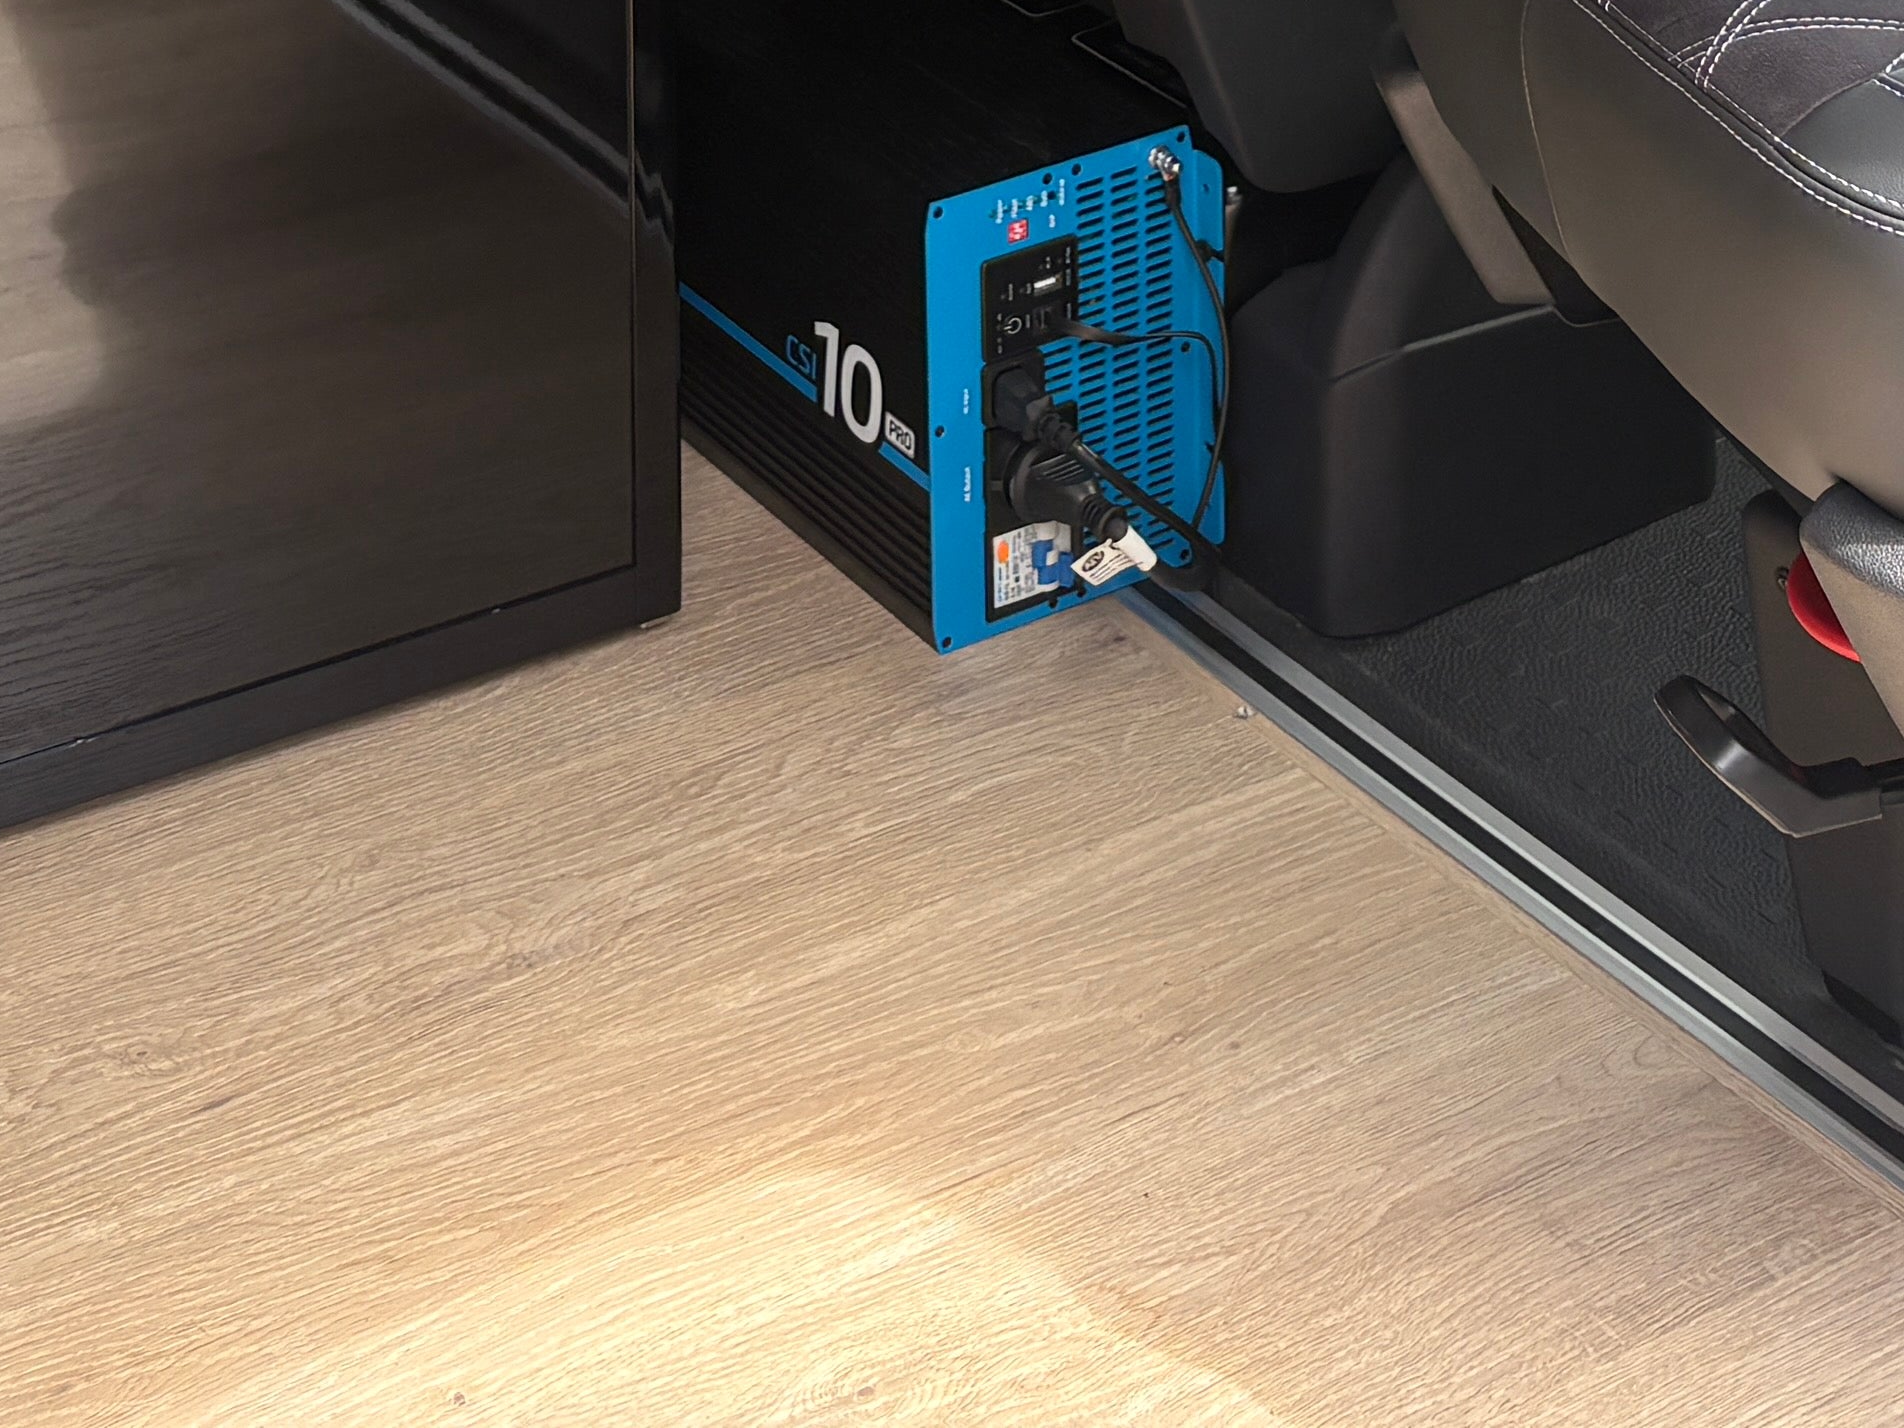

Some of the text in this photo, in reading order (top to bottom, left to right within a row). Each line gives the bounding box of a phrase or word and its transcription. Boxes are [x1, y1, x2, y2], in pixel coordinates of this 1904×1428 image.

[786, 321, 913, 451] CSI 10 PRO
